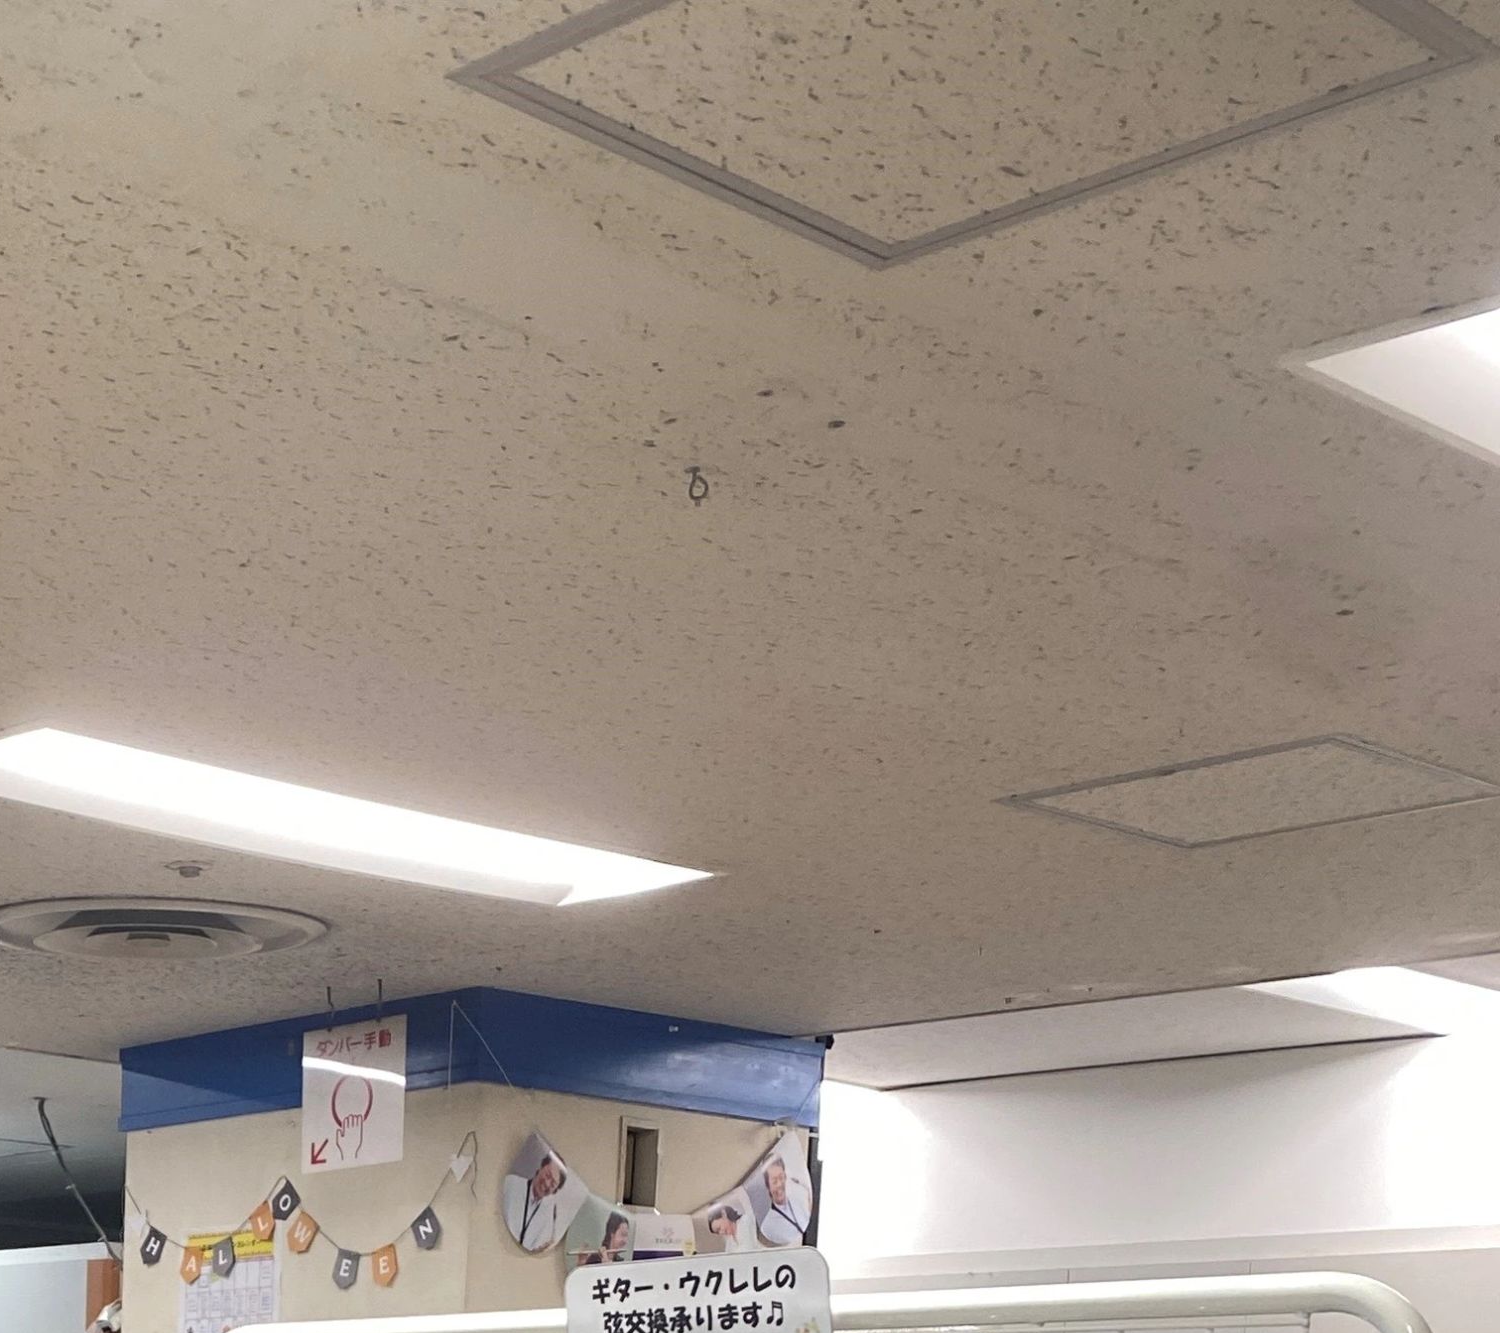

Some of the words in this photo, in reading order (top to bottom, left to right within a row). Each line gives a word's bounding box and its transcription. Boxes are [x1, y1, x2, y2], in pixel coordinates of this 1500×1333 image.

[592, 1264, 796, 1305] ギター・ウクレレの
